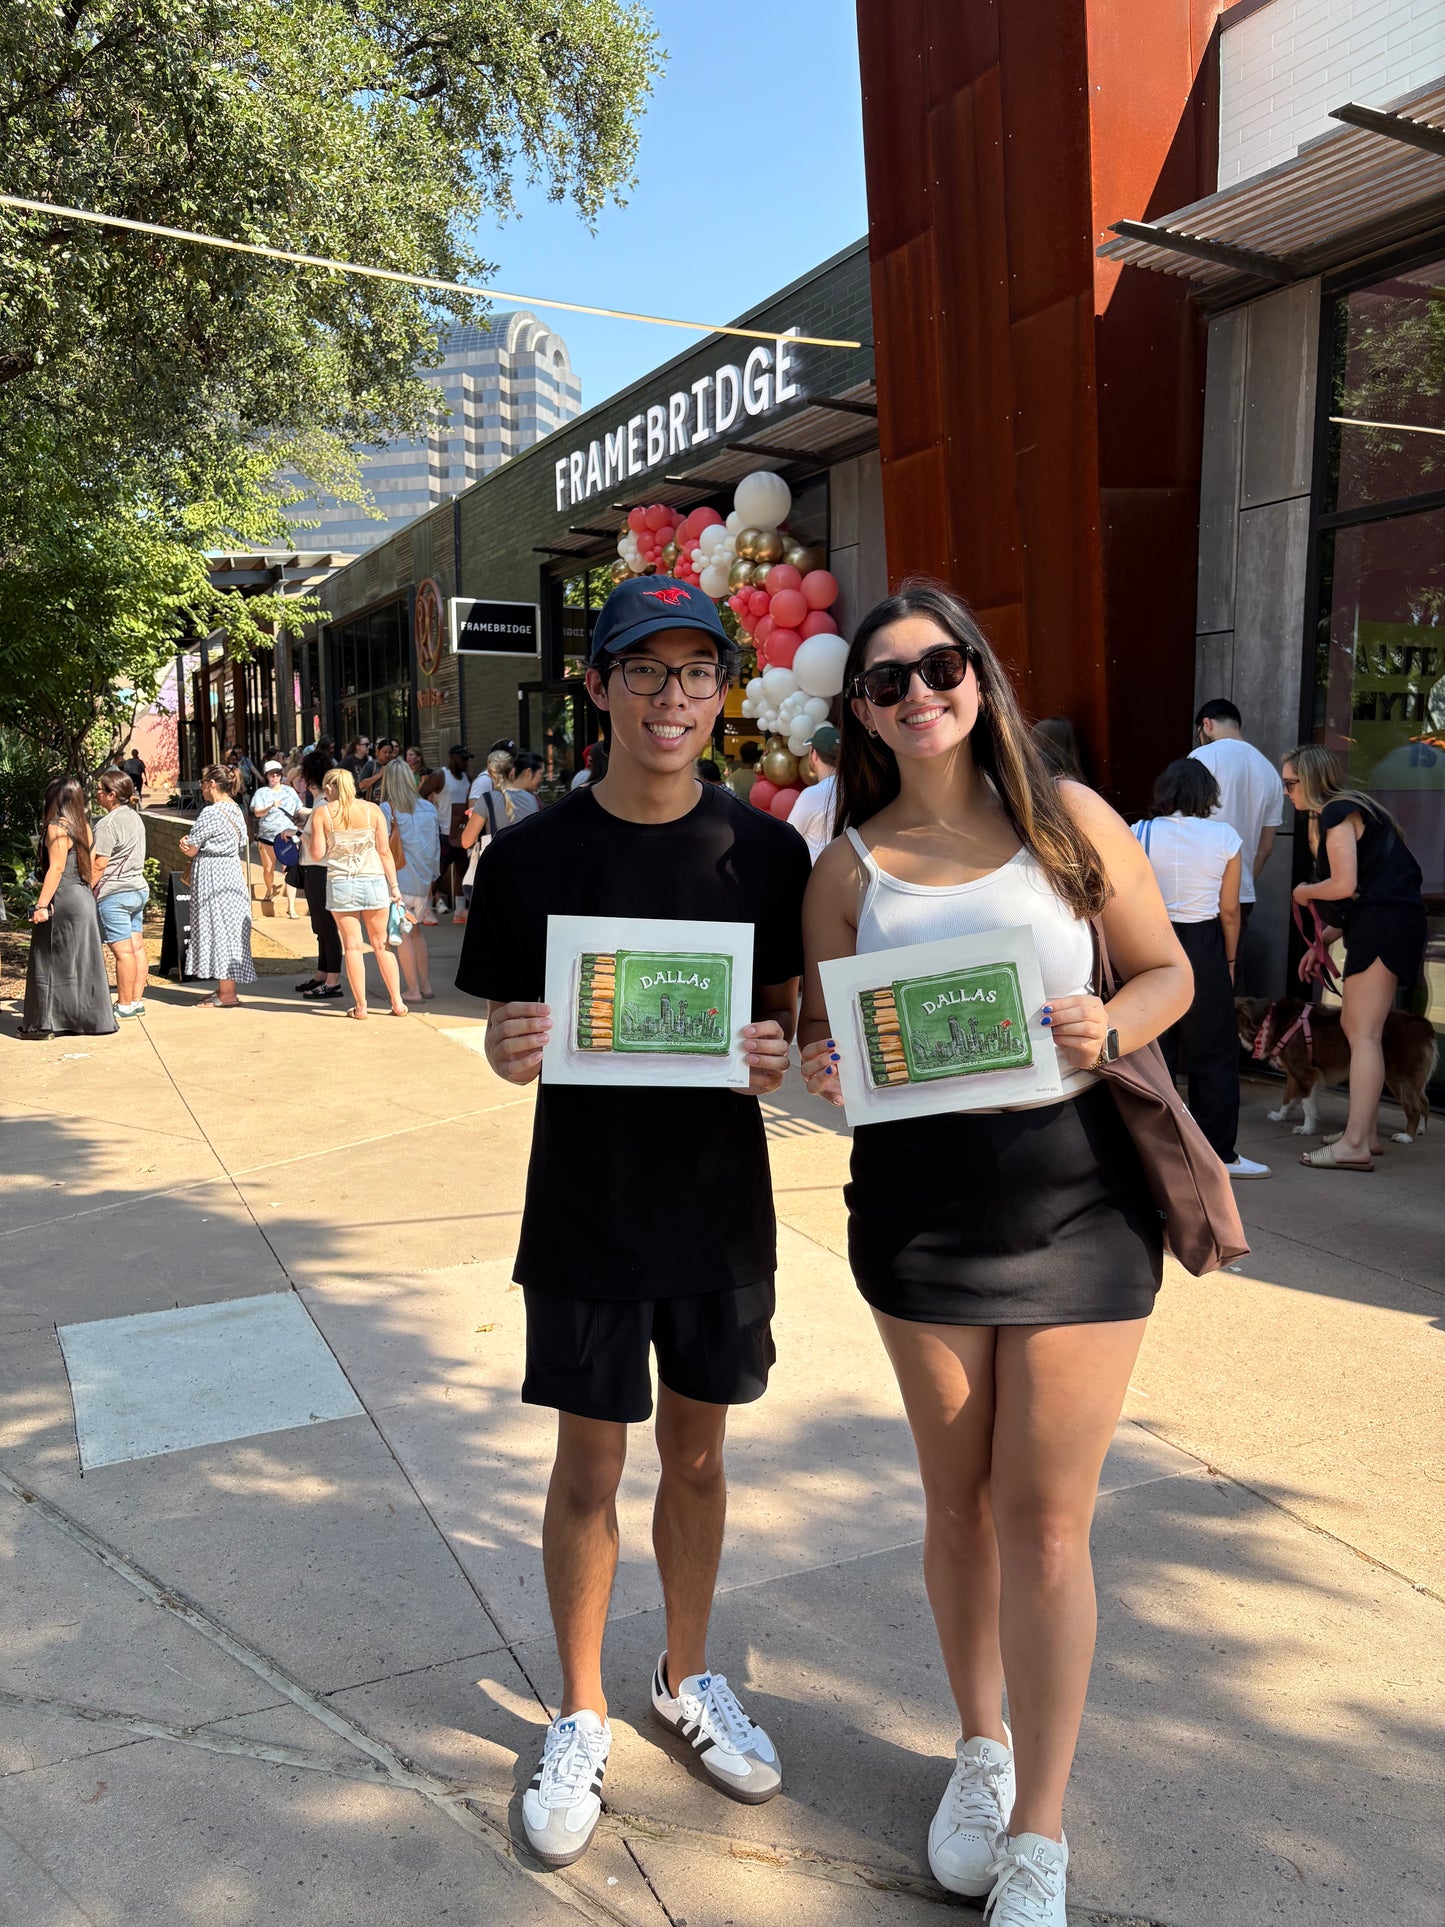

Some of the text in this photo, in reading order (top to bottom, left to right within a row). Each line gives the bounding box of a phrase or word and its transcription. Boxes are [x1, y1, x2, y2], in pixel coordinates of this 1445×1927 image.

[555, 326, 800, 512] FRAMEBRIDGE
[461, 621, 532, 634] FRAMEBRIDGE
[640, 970, 711, 990] DALLAS
[921, 988, 997, 1016] DALLAS
